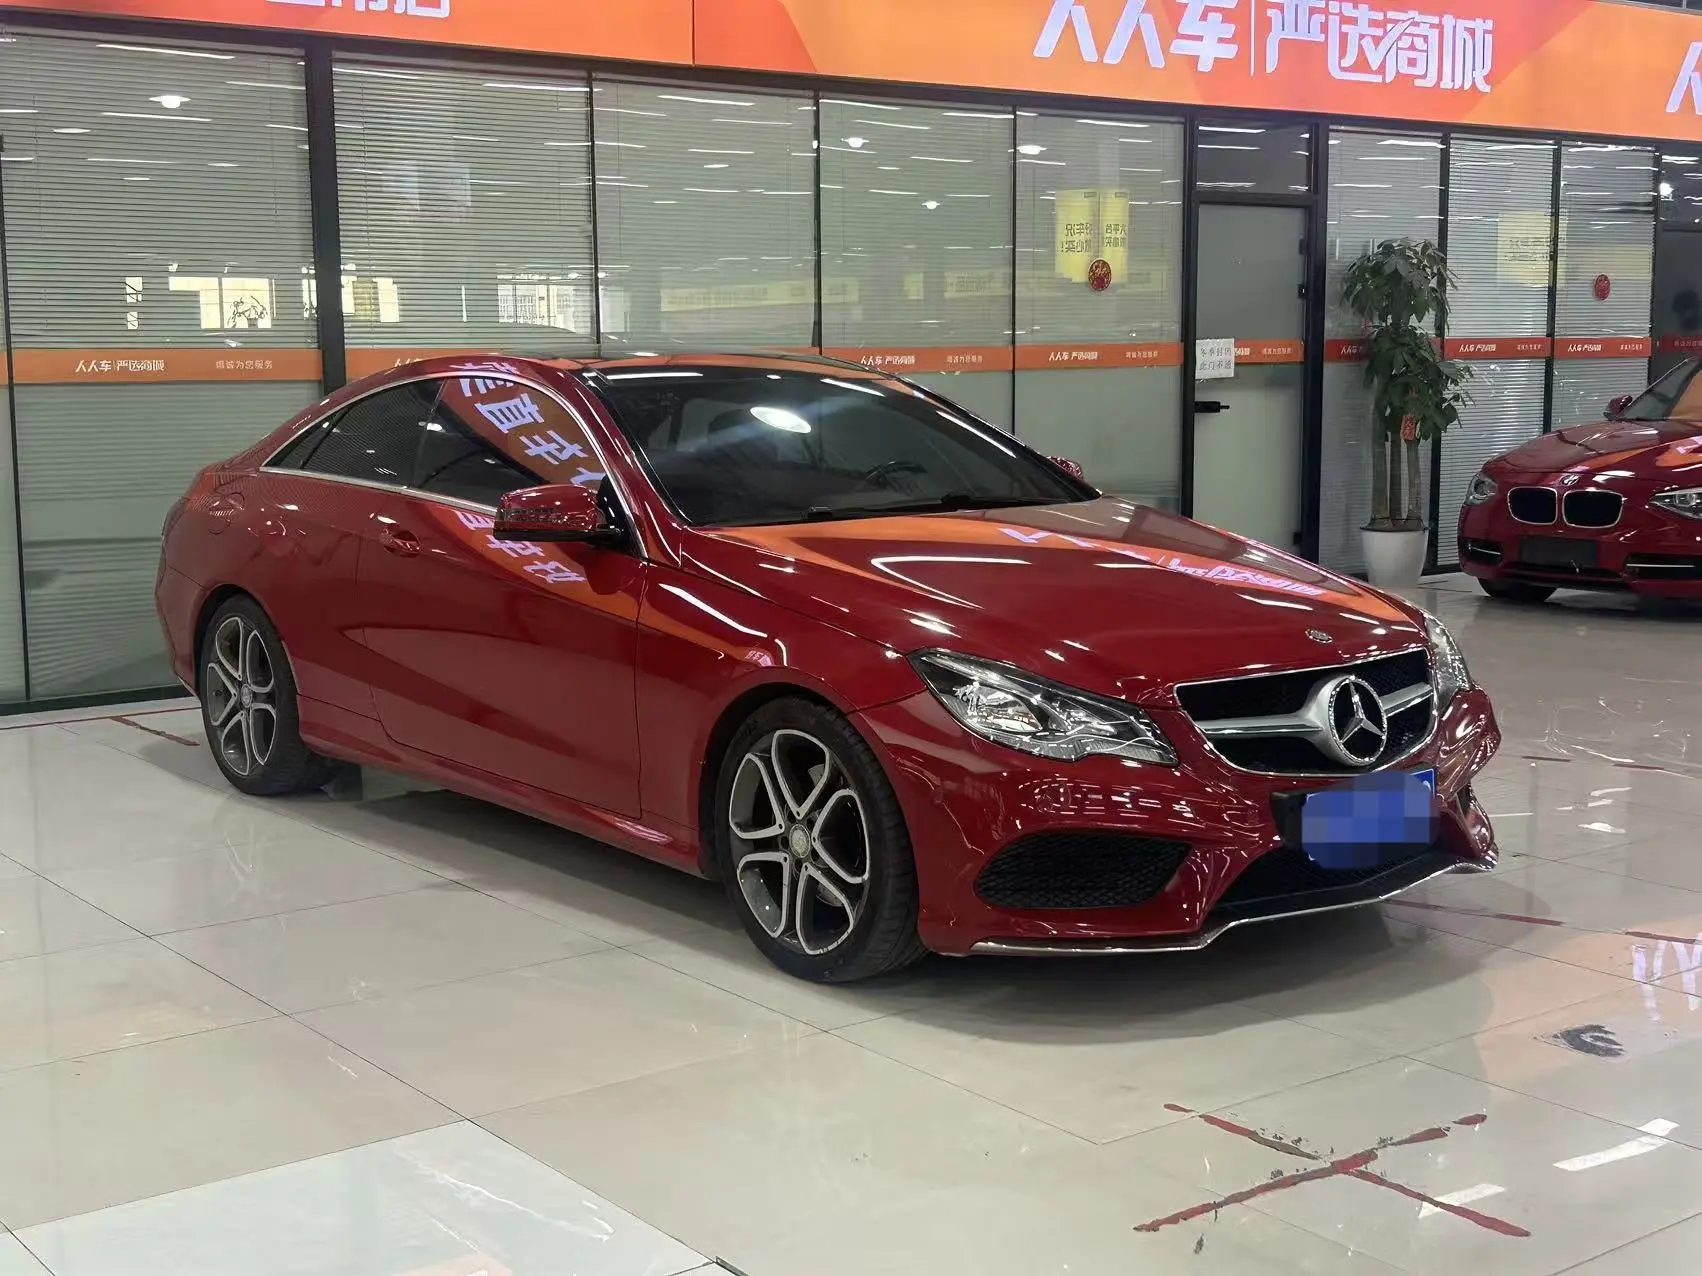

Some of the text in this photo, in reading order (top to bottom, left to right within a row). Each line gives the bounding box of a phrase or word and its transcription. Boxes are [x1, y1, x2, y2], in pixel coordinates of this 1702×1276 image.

[1033, 0, 1492, 93] 人人车 严选商城
[75, 359, 112, 373] 人人车
